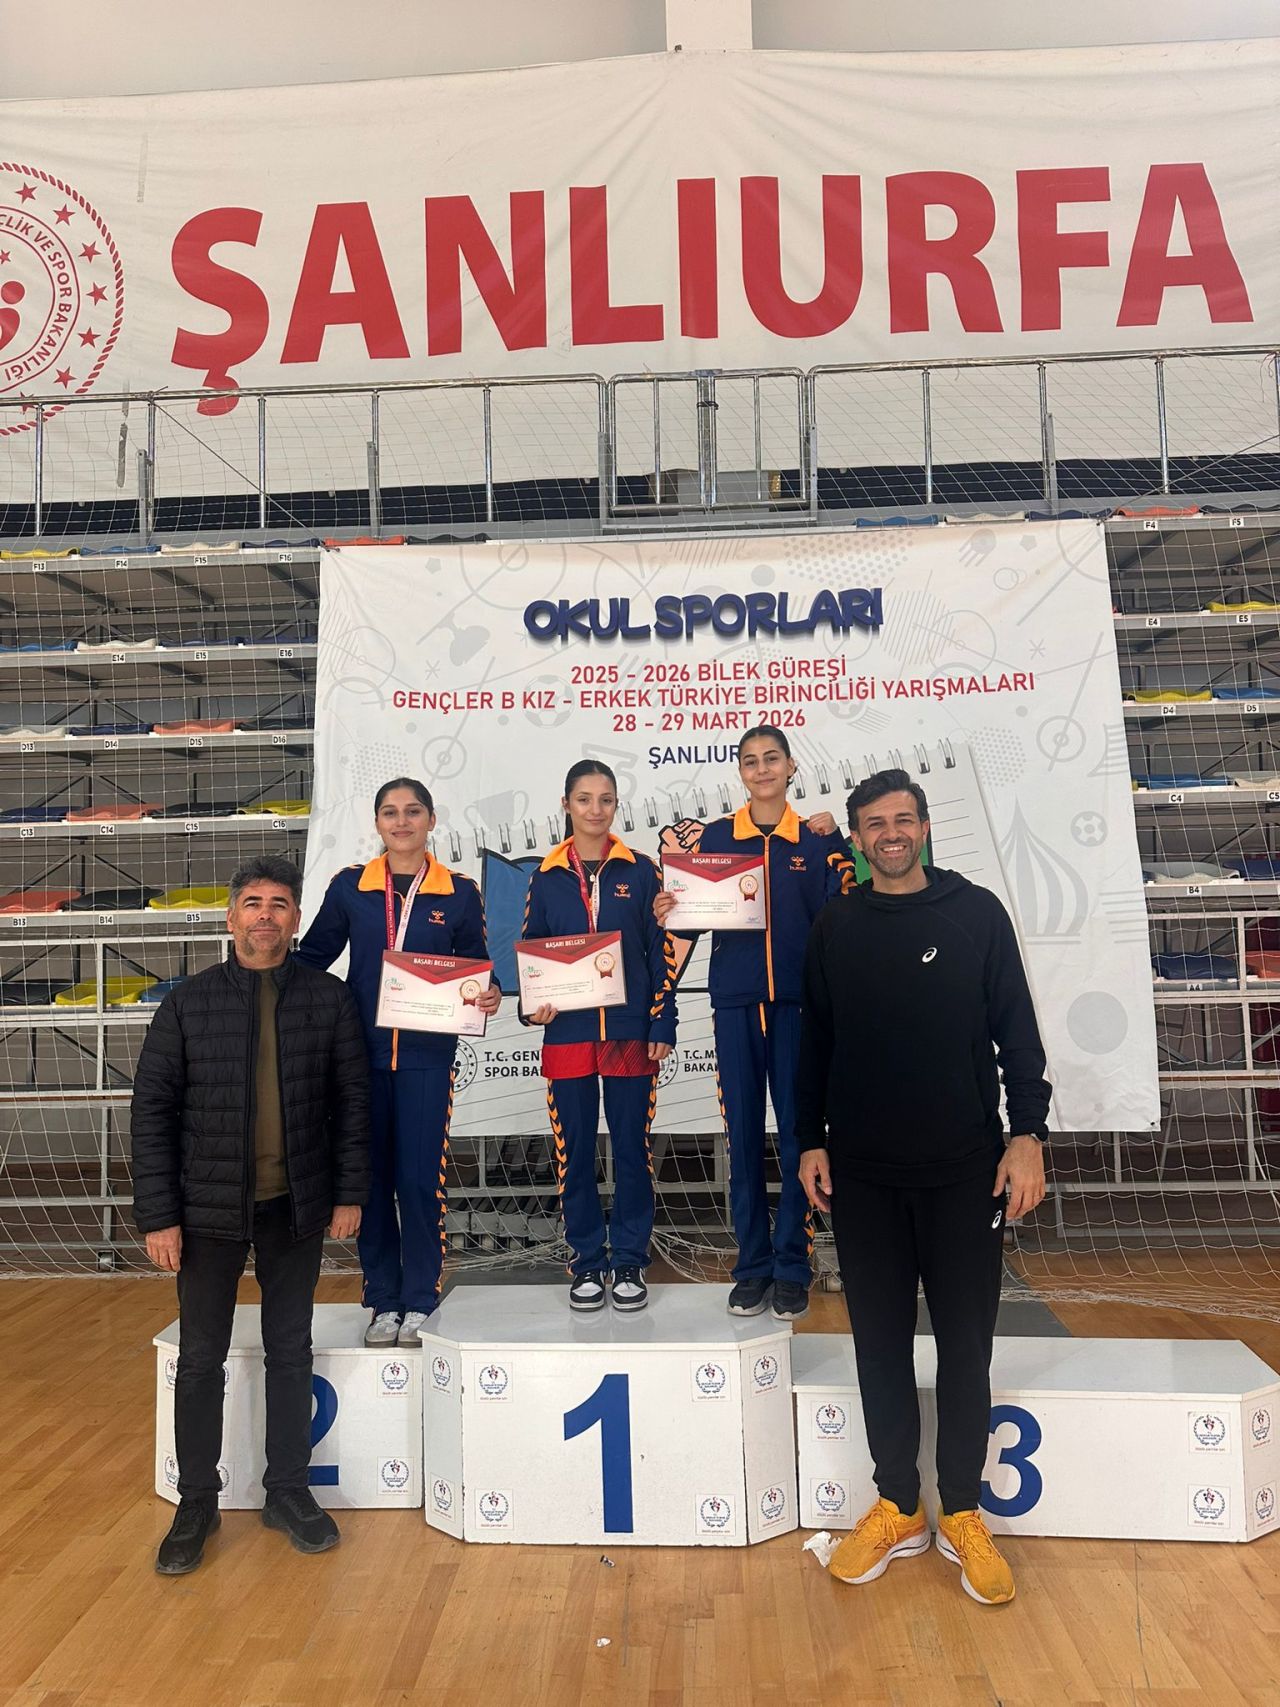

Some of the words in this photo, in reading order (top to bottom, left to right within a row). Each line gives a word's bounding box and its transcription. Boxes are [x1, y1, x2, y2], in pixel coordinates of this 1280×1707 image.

[34, 231, 54, 252] VE
[48, 251, 72, 298] SPOR
[171, 163, 1253, 416] ŞANLIURFA
[5, 303, 72, 381] BAKANLIĞI
[523, 597, 652, 639] OKUL
[654, 587, 884, 638] SPORLARI
[571, 664, 619, 685] 2025
[644, 663, 691, 683] 2026
[698, 659, 761, 682] BİLEK
[768, 654, 847, 682] GÜREŞİ
[392, 690, 494, 715] GENÇLER
[502, 692, 515, 709] B
[522, 690, 556, 710] KIZ
[580, 688, 652, 709] ERKEK
[657, 682, 747, 707] TÜRKİYE
[754, 676, 876, 704] BİRİNCİLİĞİ
[882, 672, 1035, 701] YARIŞMALARI
[612, 714, 637, 732] 28
[661, 712, 684, 732] 29
[692, 711, 751, 731] MART
[757, 709, 806, 728] 2026
[1170, 794, 1182, 802] C4
[1269, 792, 1279, 800] C5
[484, 1051, 508, 1062] T.C.
[683, 1050, 703, 1059] T.C.
[484, 1066, 519, 1077] SPOR
[564, 1373, 634, 1533] 1
[978, 1404, 1043, 1517] 3
